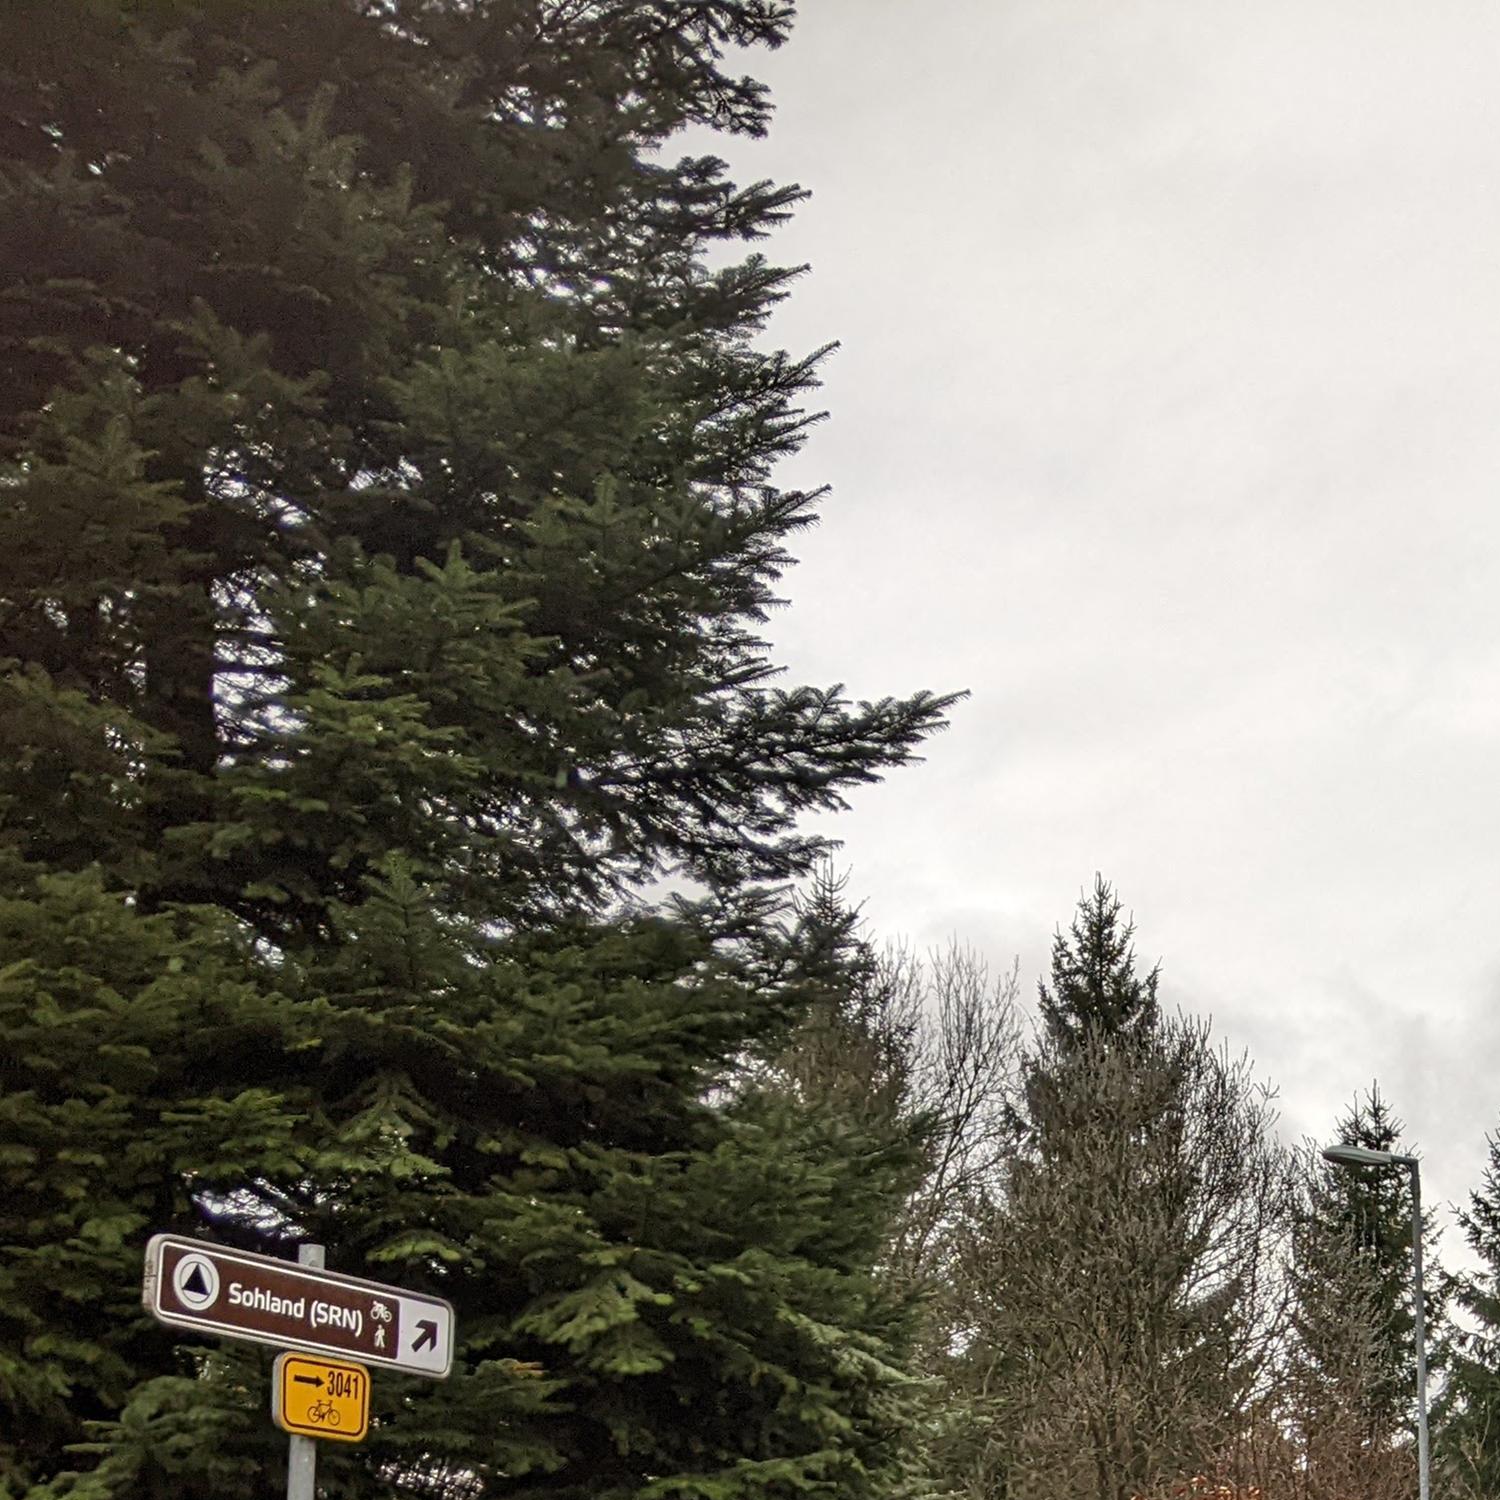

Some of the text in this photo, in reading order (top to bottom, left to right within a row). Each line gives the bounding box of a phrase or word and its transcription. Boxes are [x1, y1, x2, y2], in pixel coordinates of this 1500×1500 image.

[228, 1282, 363, 1337] Sohland (SRN)
[327, 1370, 359, 1400] 3041
